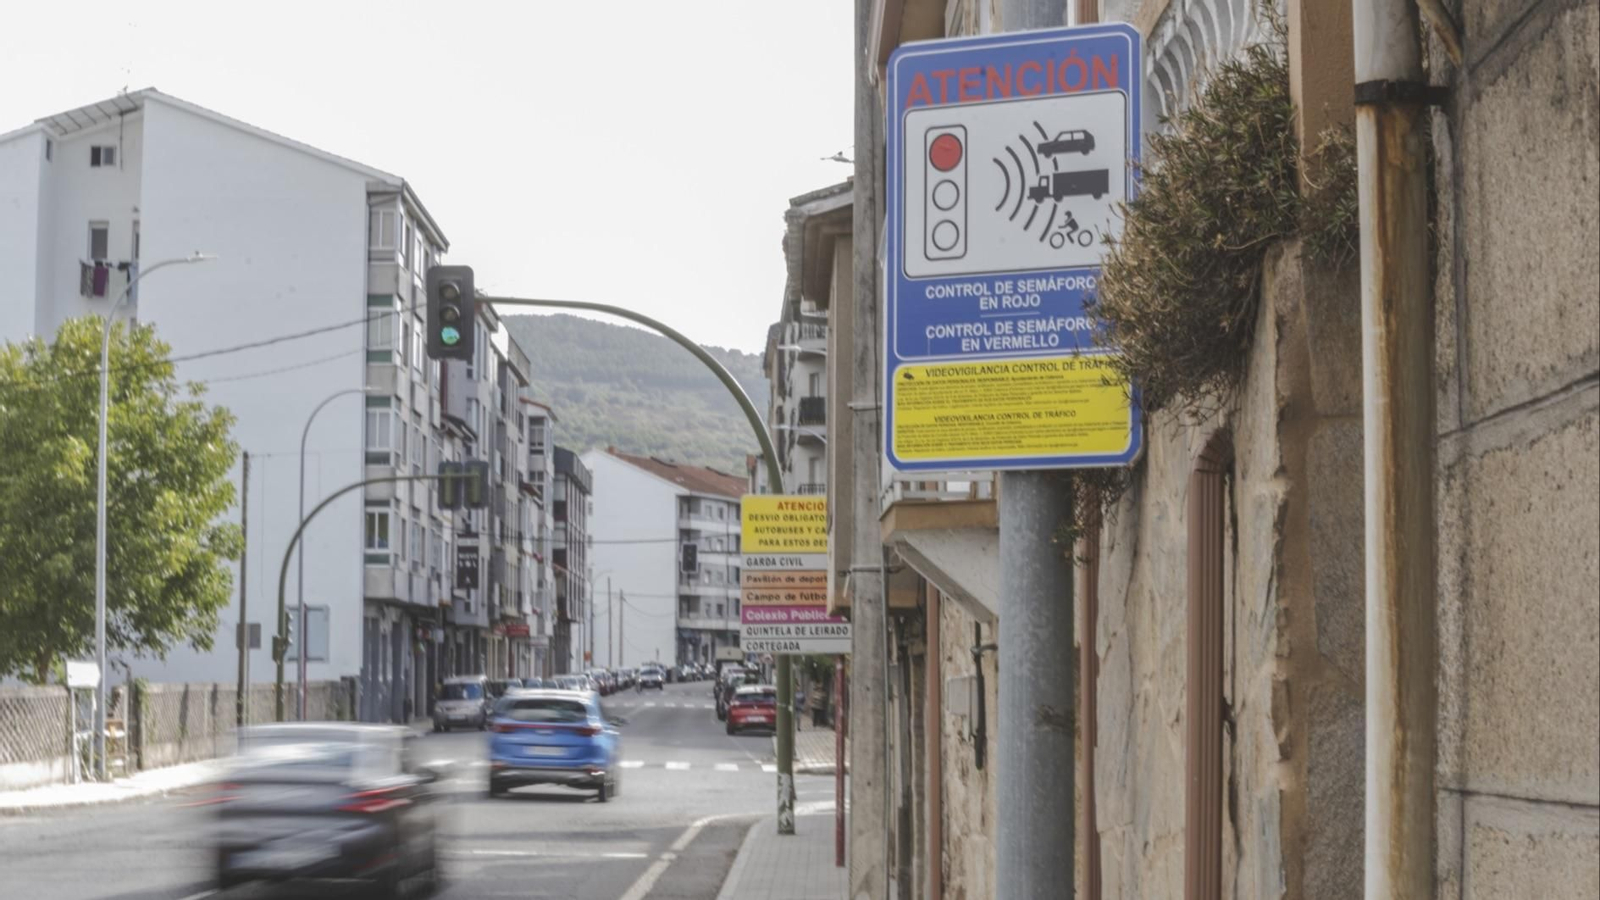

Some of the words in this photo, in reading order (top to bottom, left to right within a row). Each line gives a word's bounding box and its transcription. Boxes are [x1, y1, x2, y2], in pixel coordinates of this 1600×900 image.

[905, 48, 1118, 108] ATENCIÓN
[925, 283, 991, 300] CONTROL
[995, 280, 1014, 294] DE
[979, 297, 999, 310] EN
[1002, 294, 1041, 309] ROJO
[925, 323, 991, 340] CONTROL
[995, 321, 1014, 334] DE
[961, 337, 982, 352] EN
[985, 333, 1060, 350] VERMELLO
[925, 365, 1010, 377] VIDEOVIGILANCIA
[1012, 362, 1060, 373] CONTROL
[1062, 361, 1077, 371] DE
[996, 411, 1030, 420] CONTROL
[1032, 410, 1042, 418] DE
[777, 501, 827, 511] ATENCIO
[782, 513, 826, 522] OBLIGATO
[754, 526, 804, 534] AUTOBUSES
[807, 526, 812, 534] Y
[815, 526, 827, 534] CA
[783, 539, 811, 547] ESTOS
[746, 557, 777, 567] GARDA
[779, 557, 803, 567] CIVIL
[785, 575, 795, 583] de
[799, 575, 827, 584] deport
[746, 592, 781, 602] Campo
[784, 593, 796, 601] de
[800, 592, 827, 601] fútbo
[746, 609, 788, 620] Colexio
[746, 626, 792, 636] QUINTELA
[795, 626, 808, 636] DE
[809, 625, 849, 636] LEIRADO
[746, 641, 801, 651] CORTEGADA
